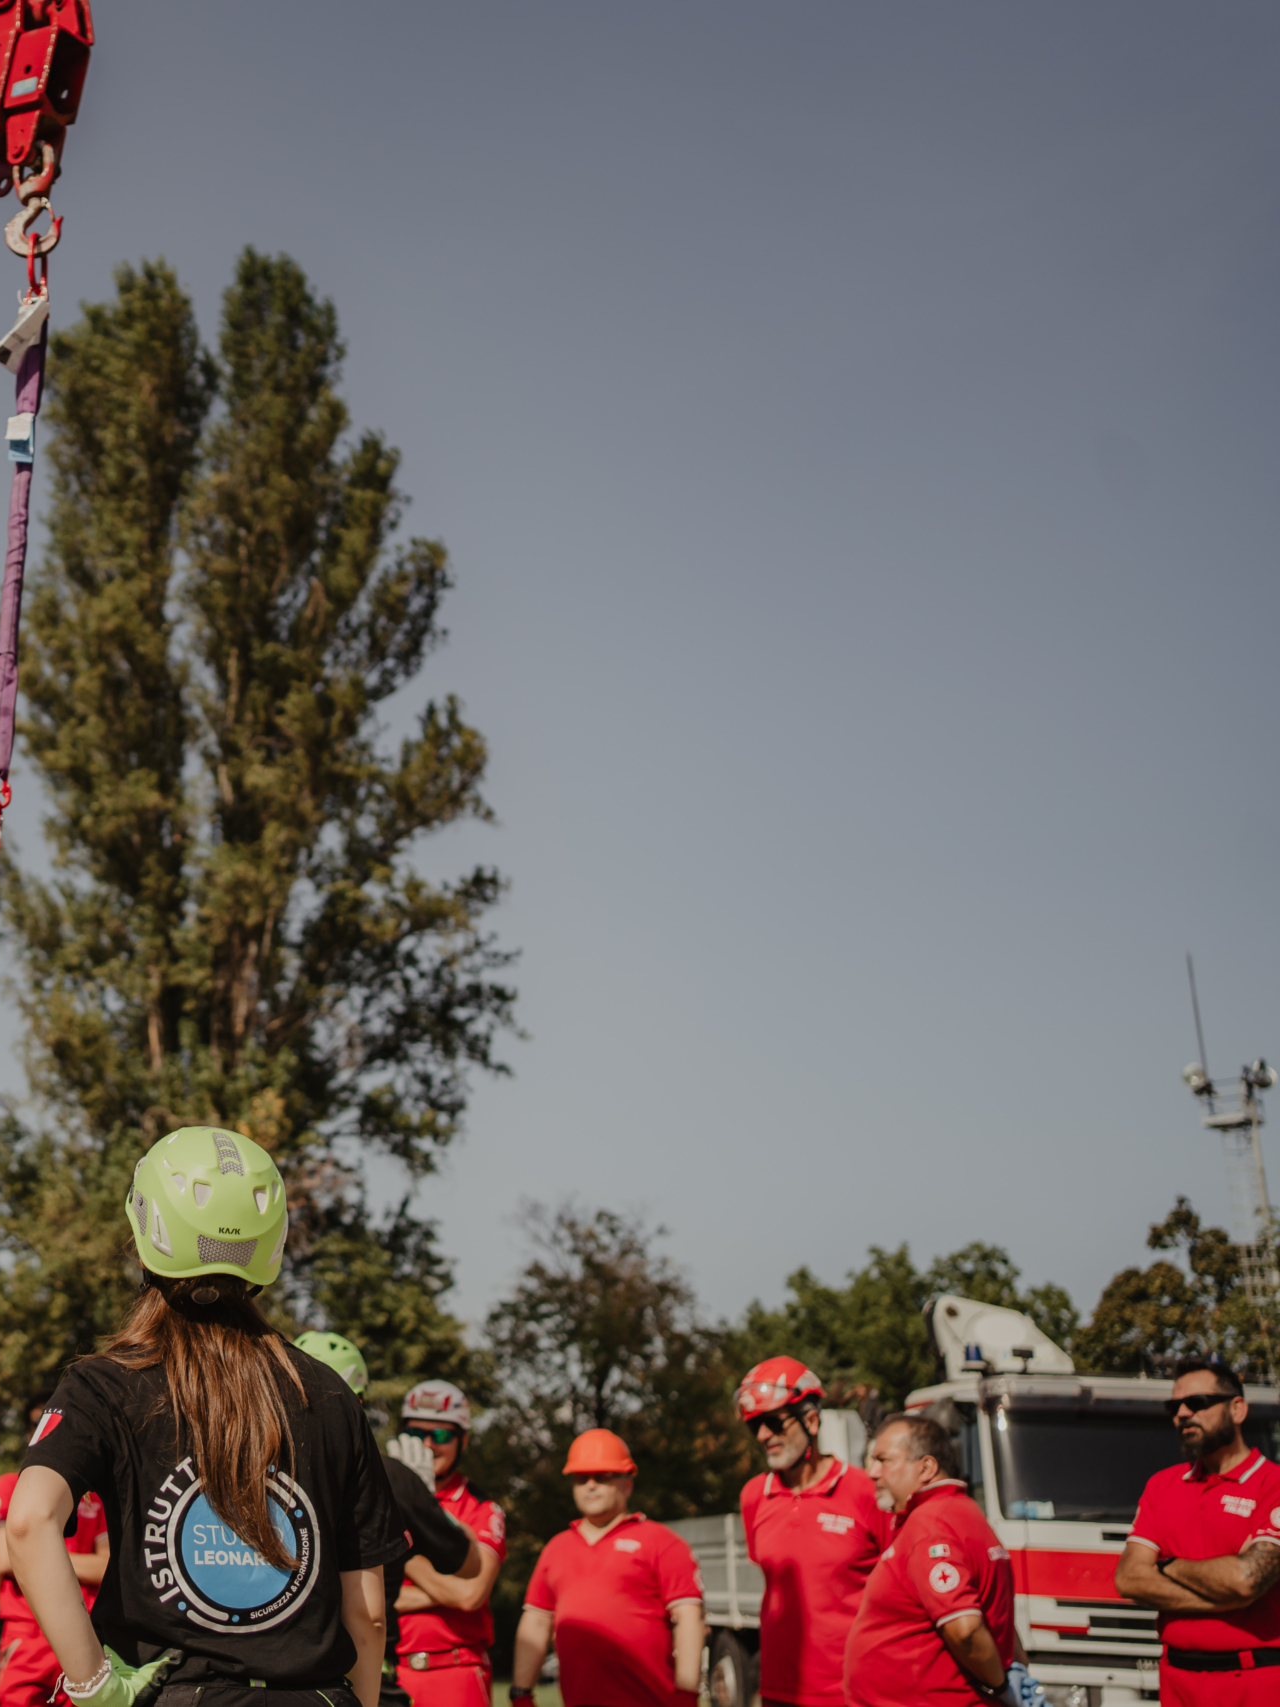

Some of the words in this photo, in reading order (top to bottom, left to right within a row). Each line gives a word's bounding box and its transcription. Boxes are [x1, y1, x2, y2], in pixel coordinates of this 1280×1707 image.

[218, 1226, 241, 1235] KASK
[194, 1550, 273, 1566] LEONAR
[293, 1527, 310, 1587] FORMAZIONE
[290, 1585, 298, 1593] &
[250, 1591, 293, 1619] SICUREZZA
